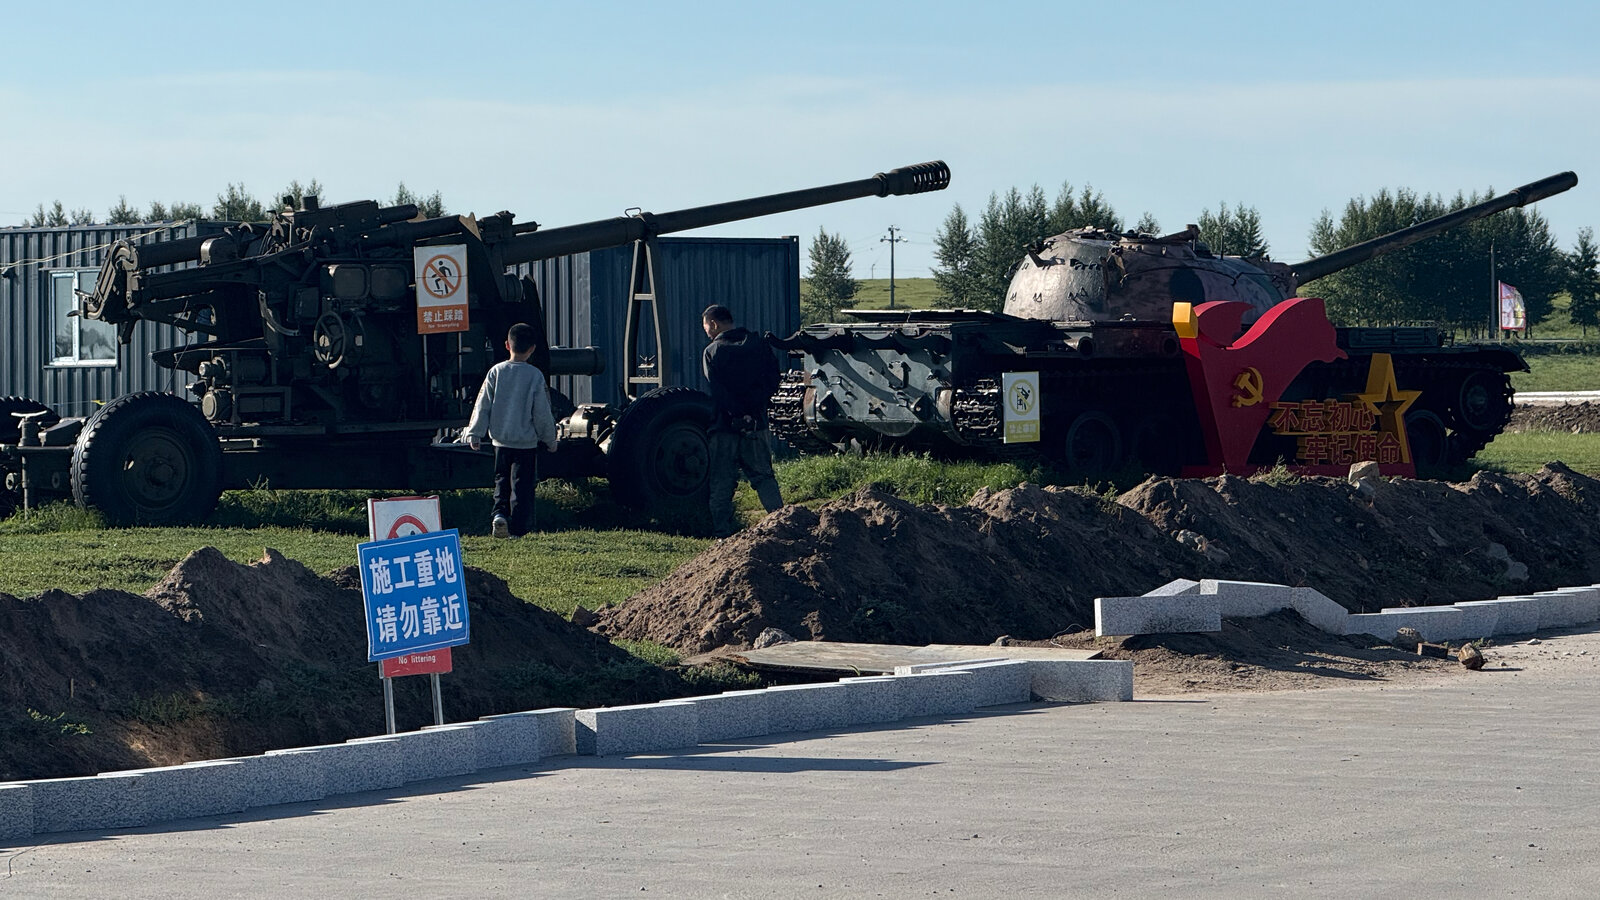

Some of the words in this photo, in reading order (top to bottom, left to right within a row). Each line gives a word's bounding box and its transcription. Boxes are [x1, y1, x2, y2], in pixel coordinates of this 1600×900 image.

[423, 309, 463, 323] 禁止踩踏
[1273, 401, 1376, 432] 不忘初心
[1304, 431, 1401, 466] 牢记使命
[369, 546, 457, 595] 施工重地
[376, 593, 463, 643] 请勿靠近
[398, 656, 408, 664] No
[411, 653, 436, 663] littering
